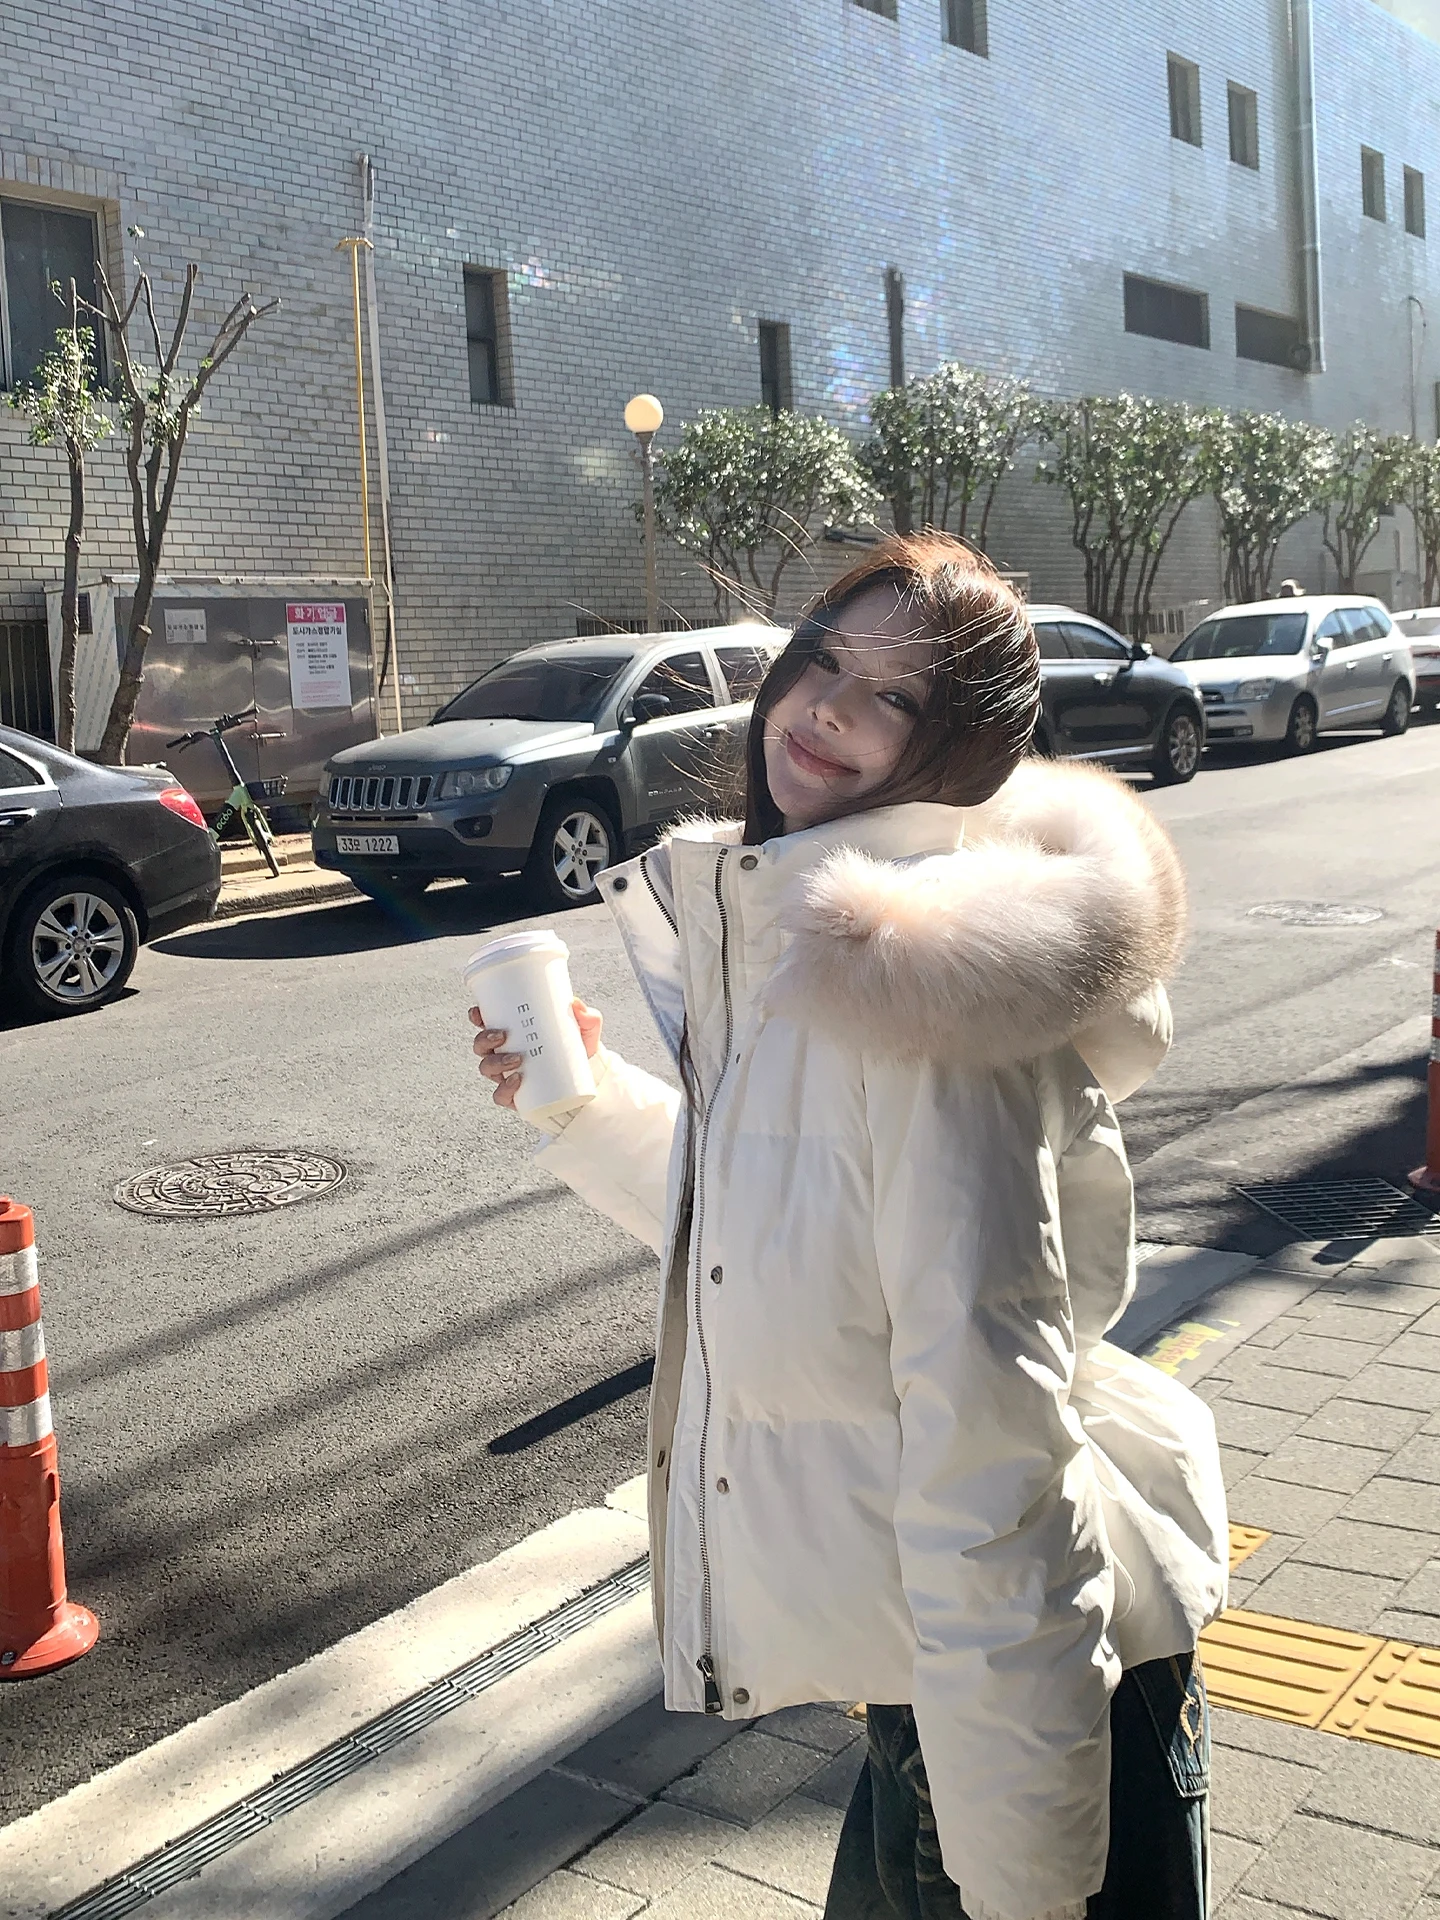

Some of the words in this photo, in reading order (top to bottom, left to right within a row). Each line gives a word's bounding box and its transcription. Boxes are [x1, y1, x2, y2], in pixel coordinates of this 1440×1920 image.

[365, 838, 393, 851] 1222
[517, 1003, 530, 1014] m
[521, 1016, 535, 1028] ur
[525, 1031, 539, 1042] m
[529, 1045, 543, 1057] ur
